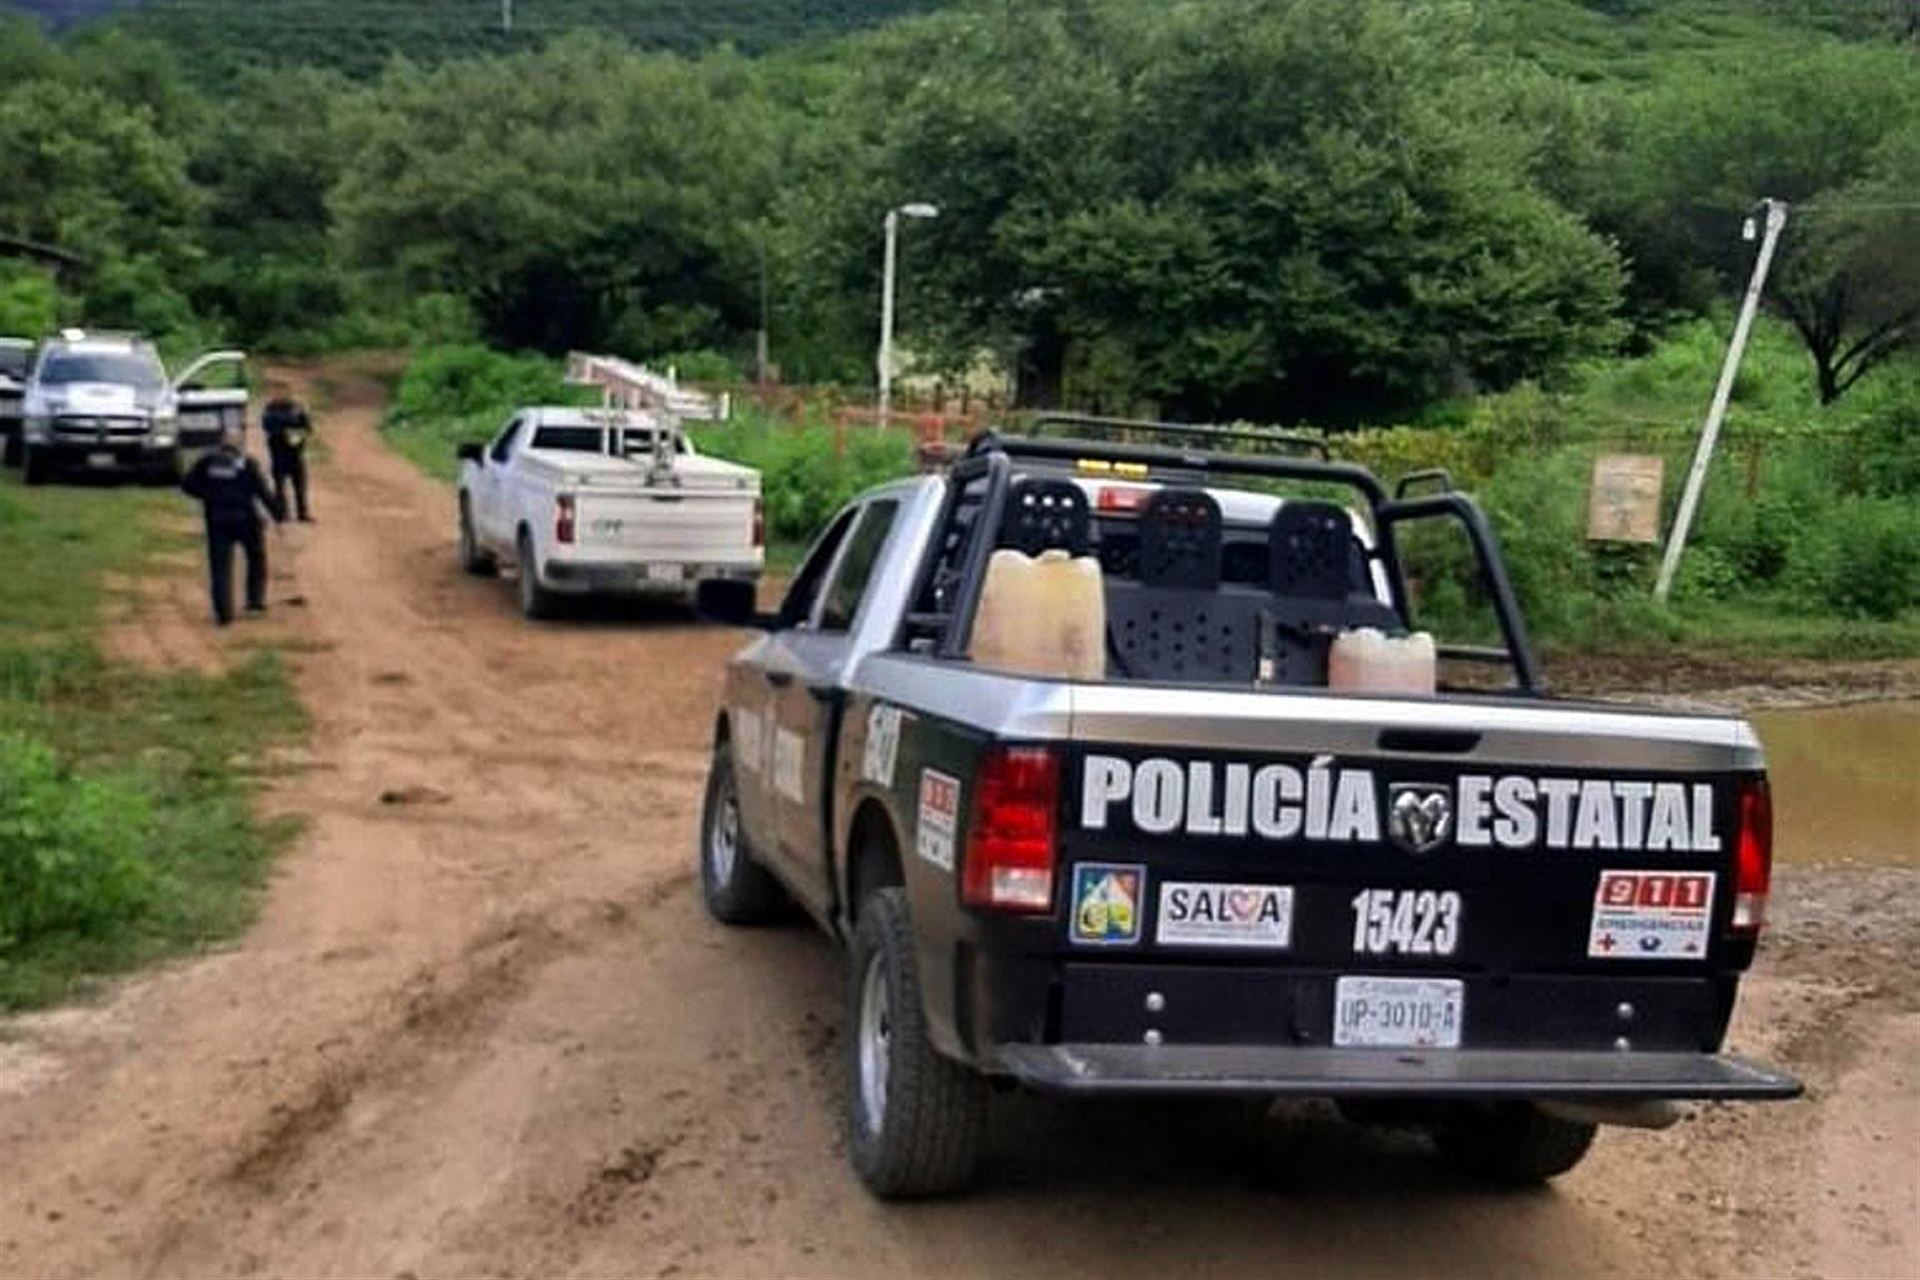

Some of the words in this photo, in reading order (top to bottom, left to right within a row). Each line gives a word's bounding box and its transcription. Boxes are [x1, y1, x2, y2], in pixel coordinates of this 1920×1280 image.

[1081, 753, 1380, 841] POLICÍA
[1456, 775, 1721, 850] ESTATAL
[1351, 888, 1461, 955] 15423
[1609, 879, 1699, 903] 911
